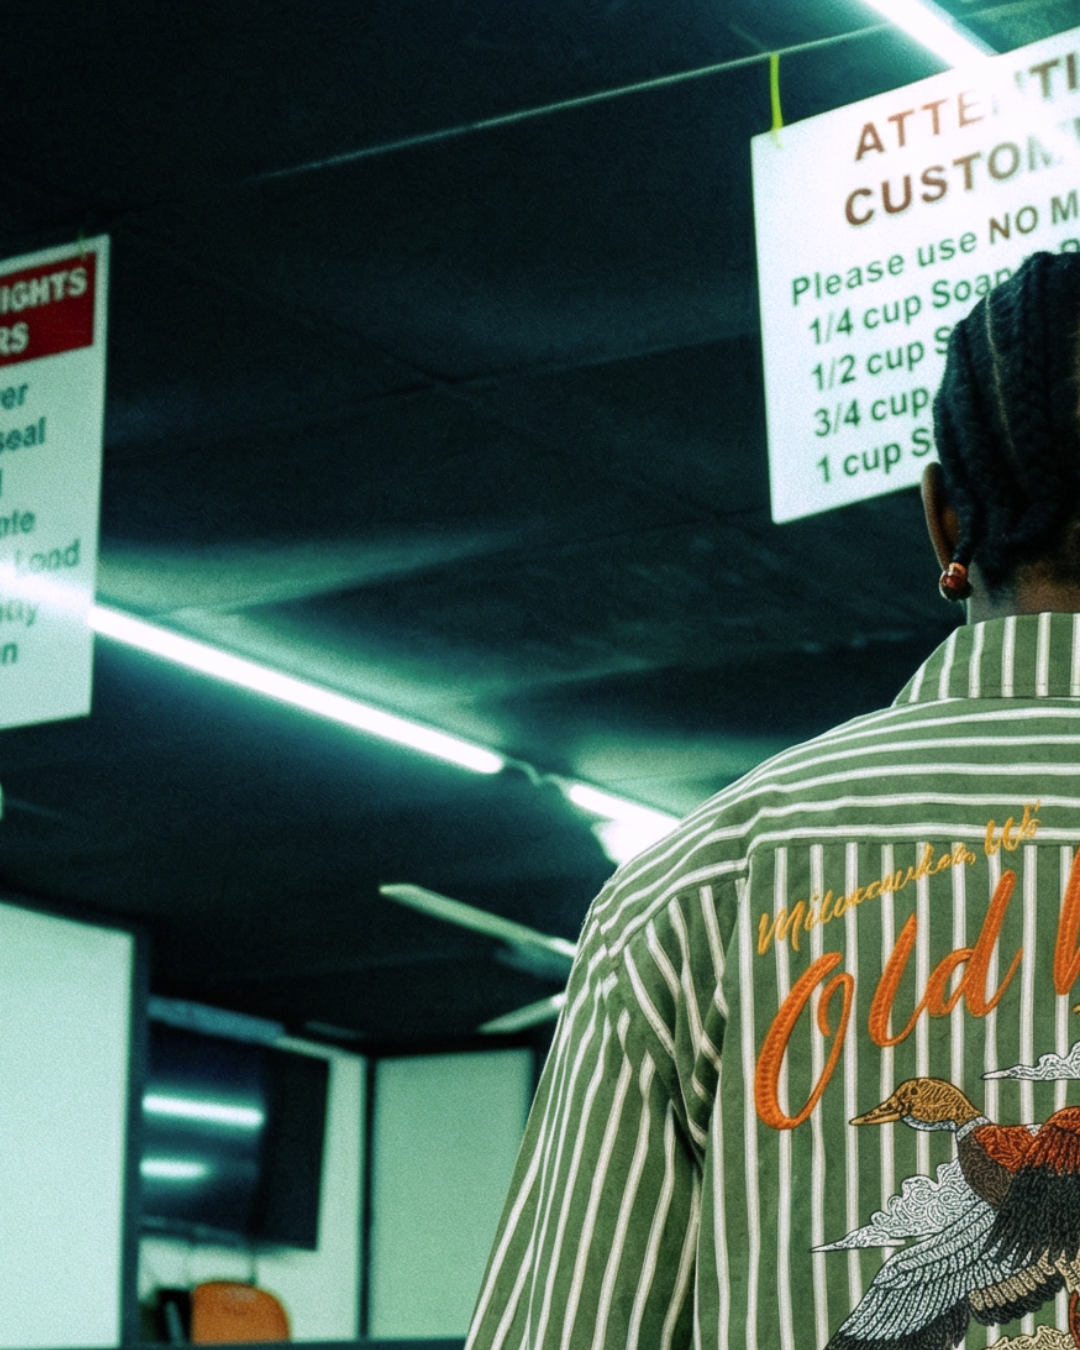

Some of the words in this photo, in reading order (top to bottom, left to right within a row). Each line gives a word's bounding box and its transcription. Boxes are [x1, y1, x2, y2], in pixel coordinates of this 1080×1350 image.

[792, 253, 905, 308] Please
[917, 231, 978, 269] use
[989, 205, 1040, 244] NO
[809, 306, 854, 346] 1/4
[863, 294, 922, 327] cup
[811, 353, 856, 391] 1/2
[866, 340, 925, 373] cup
[0, 416, 47, 452] eal
[813, 398, 861, 438] 3/4
[871, 387, 930, 419] cup
[817, 454, 831, 484] 1
[843, 442, 902, 476] cup
[754, 870, 1024, 1131] Old
